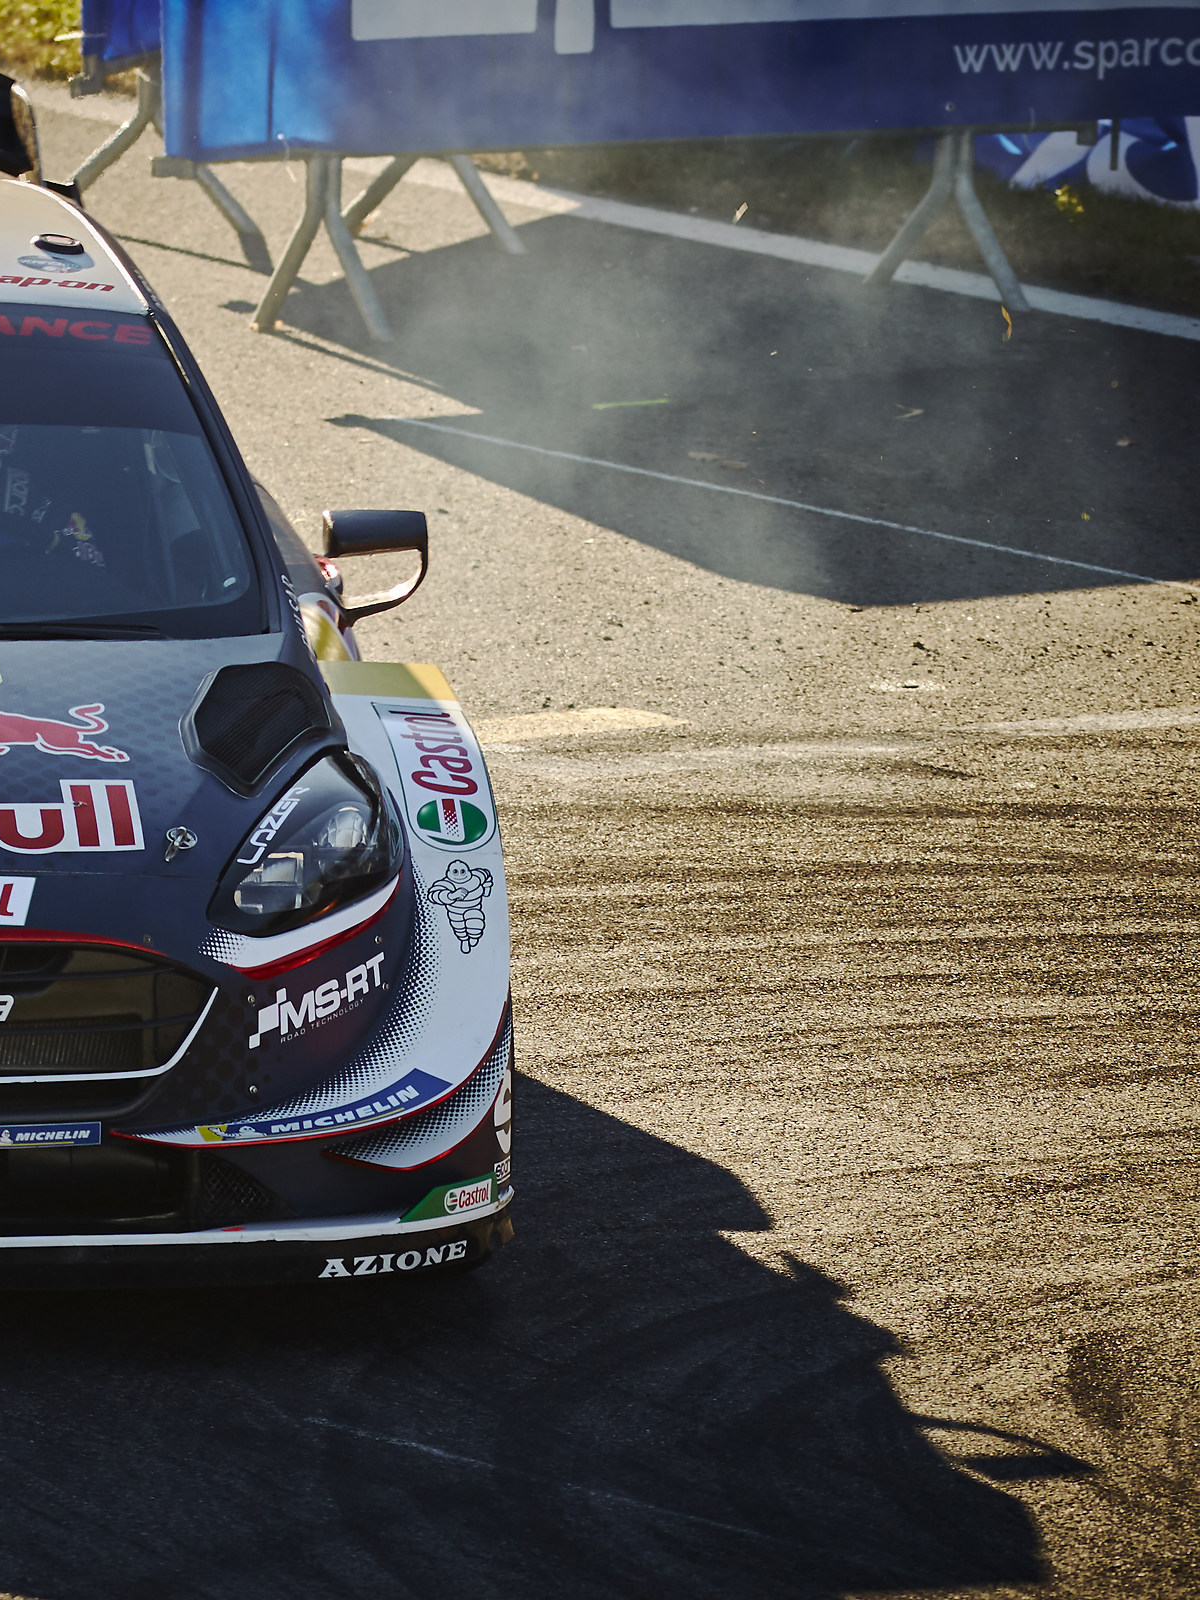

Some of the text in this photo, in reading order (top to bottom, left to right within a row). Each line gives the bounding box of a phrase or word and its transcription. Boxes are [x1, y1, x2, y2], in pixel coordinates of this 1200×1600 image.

[388, 710, 479, 796] Castrol
[280, 998, 365, 1044] ROAD TECHNOLOGY
[270, 1084, 420, 1134] MICHELIN
[15, 1129, 91, 1142] MICHELIN
[458, 1183, 490, 1209] Castrol
[317, 1240, 468, 1279] AZIONE
